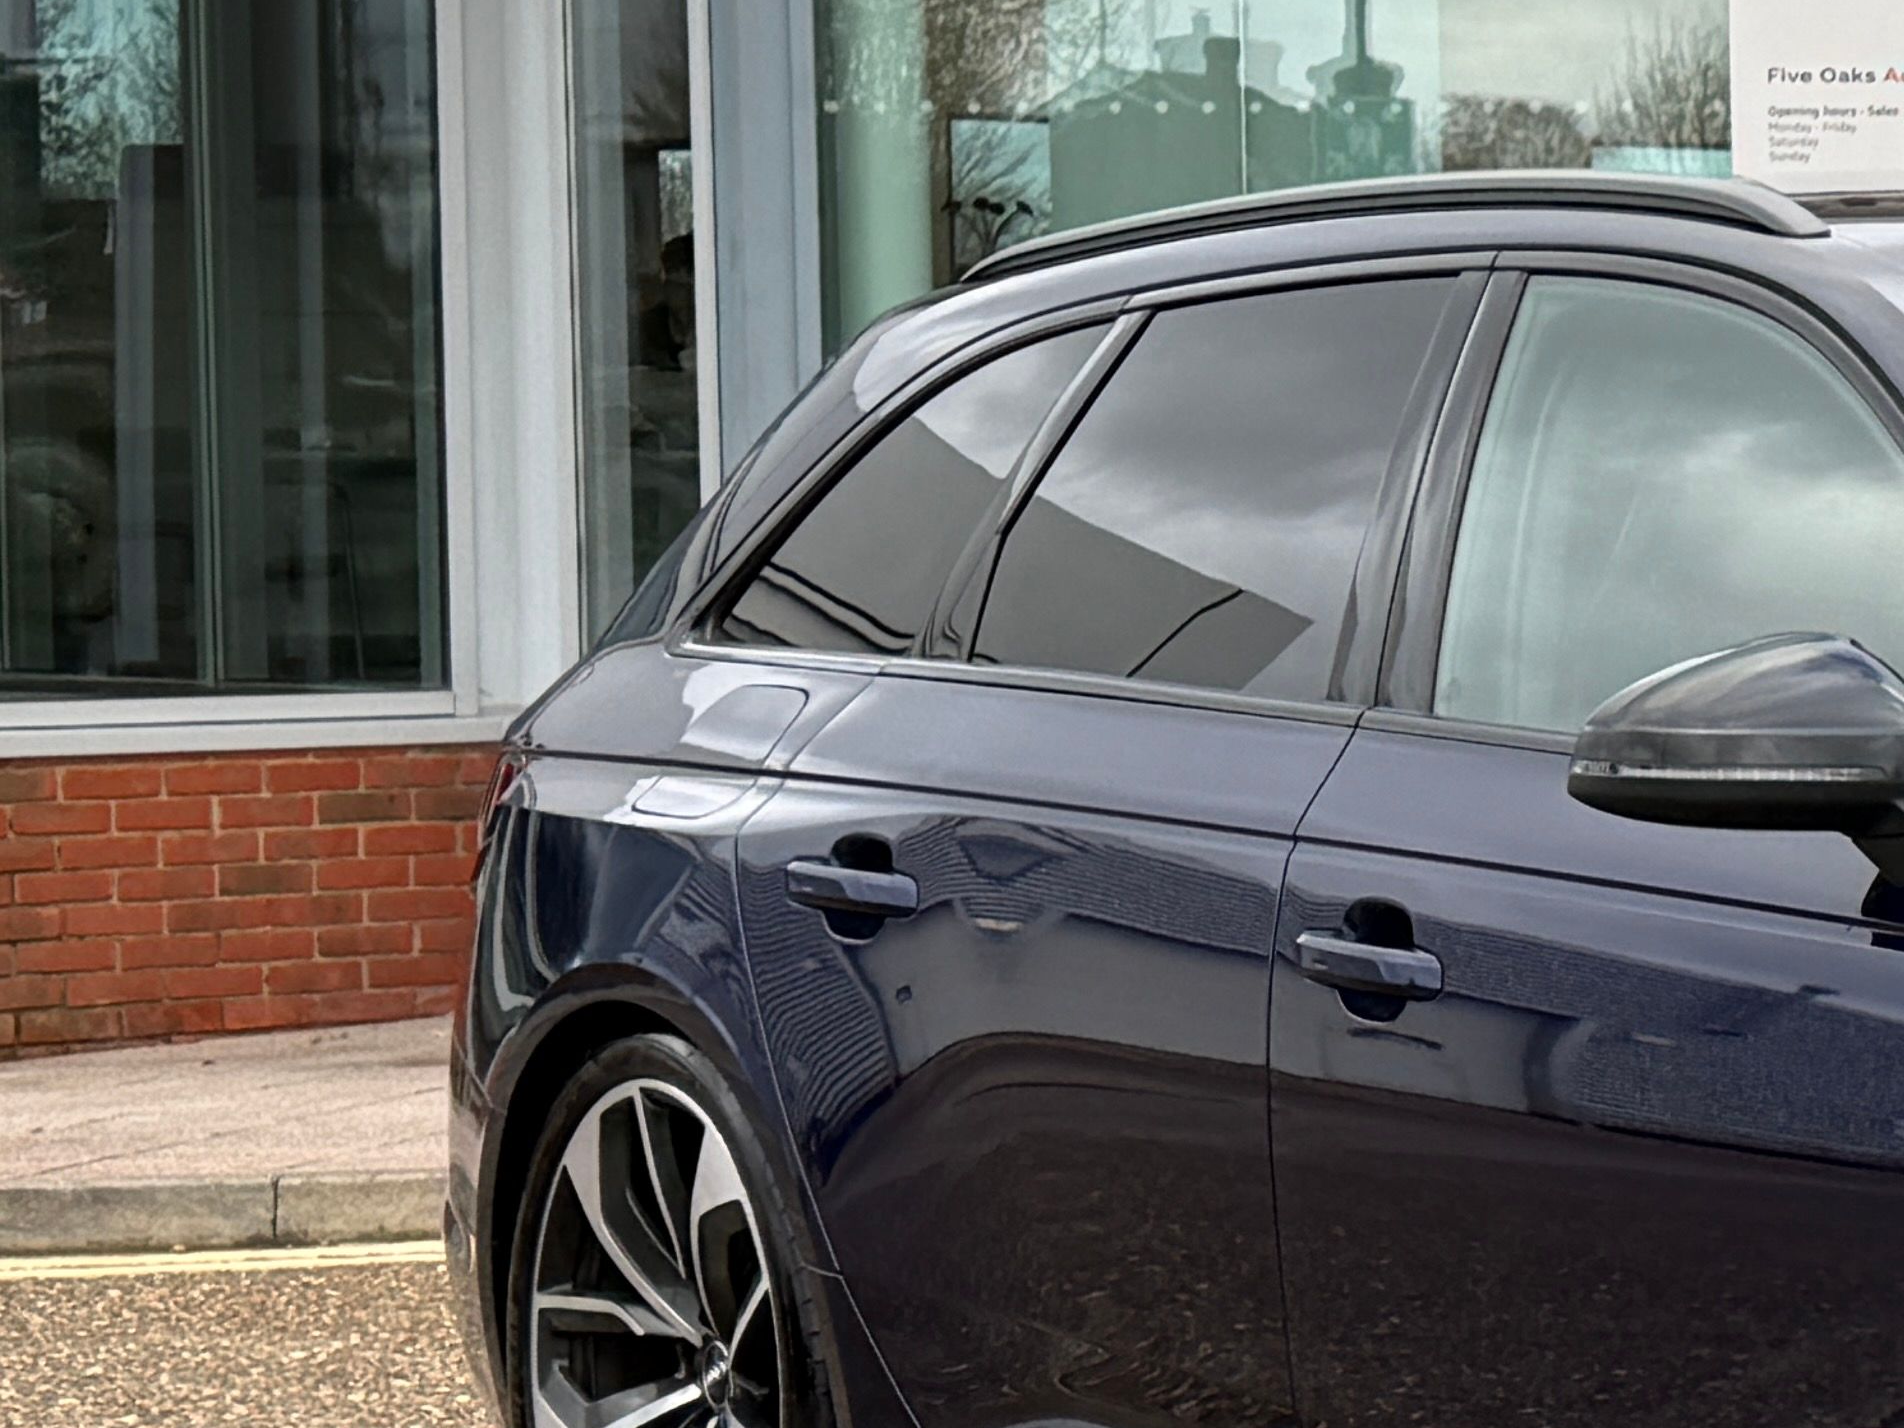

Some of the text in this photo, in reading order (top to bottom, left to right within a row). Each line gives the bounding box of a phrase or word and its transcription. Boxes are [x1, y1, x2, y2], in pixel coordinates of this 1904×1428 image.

[1768, 67, 1812, 84] Five
[1820, 67, 1876, 84] Oaks
[1768, 105, 1819, 120] Opening
[1823, 105, 1857, 118] hours
[1868, 105, 1899, 117] Sales
[1768, 122, 1812, 134] Monday
[1822, 122, 1856, 135] Friday
[1768, 136, 1819, 150] Saturday
[1768, 151, 1811, 164] Sunday
